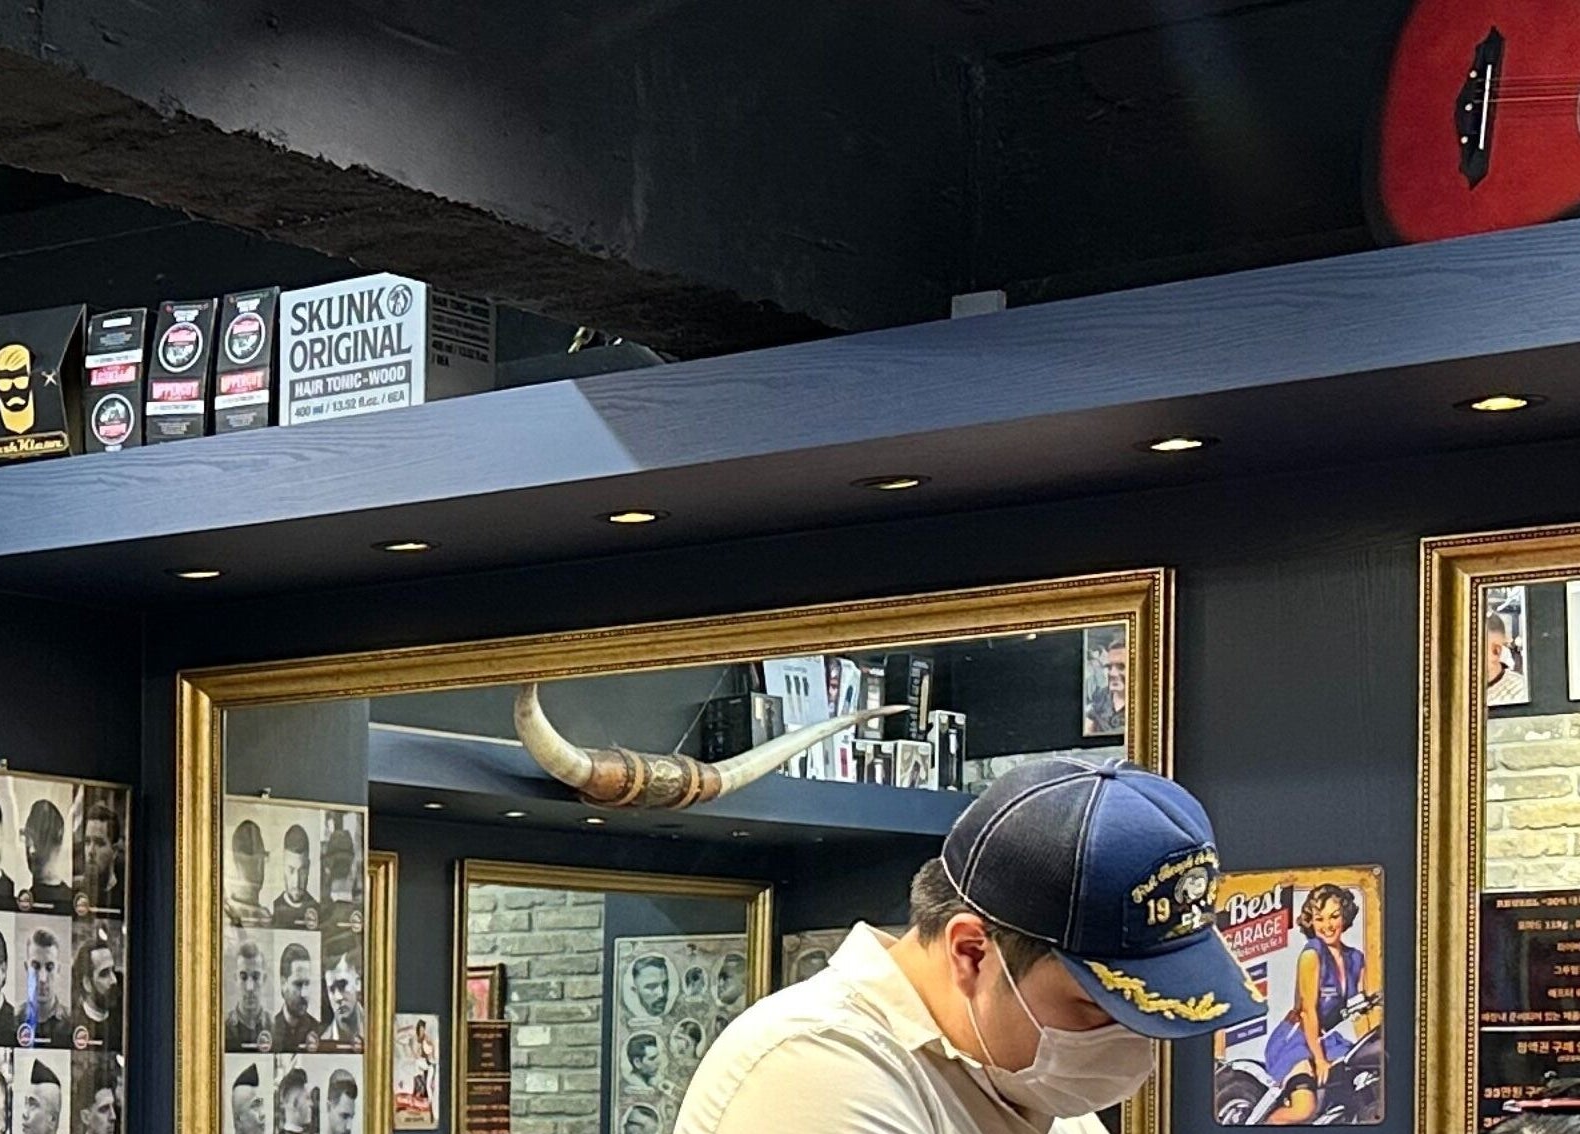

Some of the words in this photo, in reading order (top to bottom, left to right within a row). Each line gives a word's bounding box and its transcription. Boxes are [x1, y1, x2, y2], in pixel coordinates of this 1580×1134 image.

[290, 287, 386, 336] SKUNK
[289, 322, 412, 373] ORIGINAL
[295, 379, 322, 398] HAIR
[326, 365, 406, 393] TONIC-WOOD
[1225, 884, 1284, 925] Best
[1223, 915, 1283, 949] GARAGE
